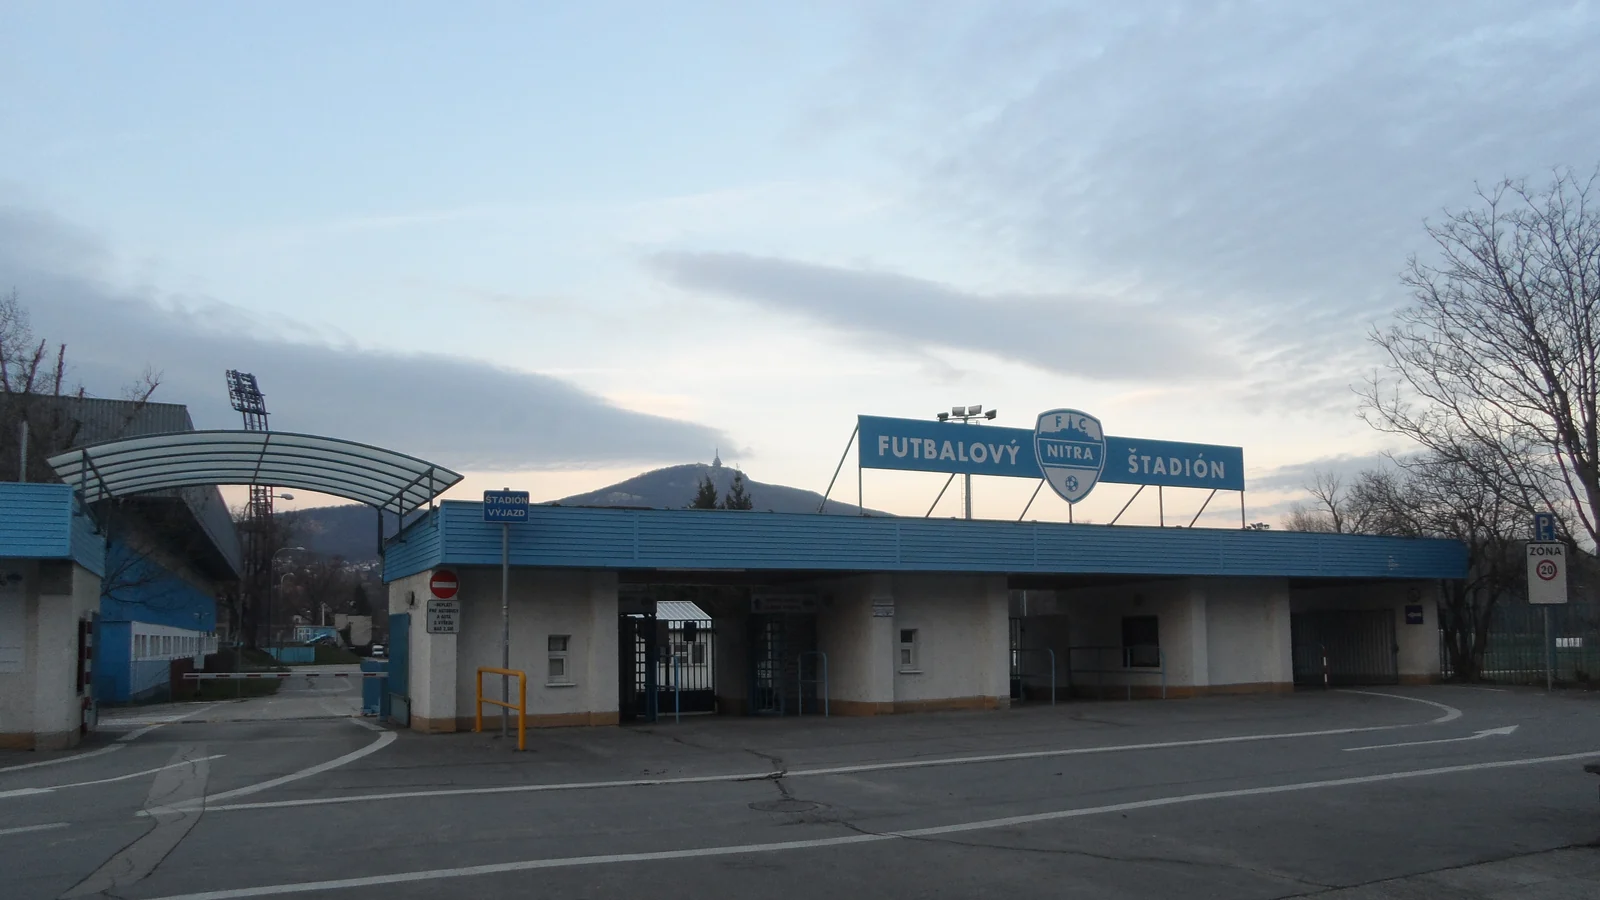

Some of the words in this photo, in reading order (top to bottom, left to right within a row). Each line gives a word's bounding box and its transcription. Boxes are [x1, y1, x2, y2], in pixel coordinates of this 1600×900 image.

[878, 435, 1020, 465] FUTBALOVÝ
[1047, 443, 1094, 461] NITRA
[1128, 447, 1225, 479] ŠTADIÓN
[488, 507, 525, 516] VÝJAZD
[1540, 565, 1553, 575] 20
